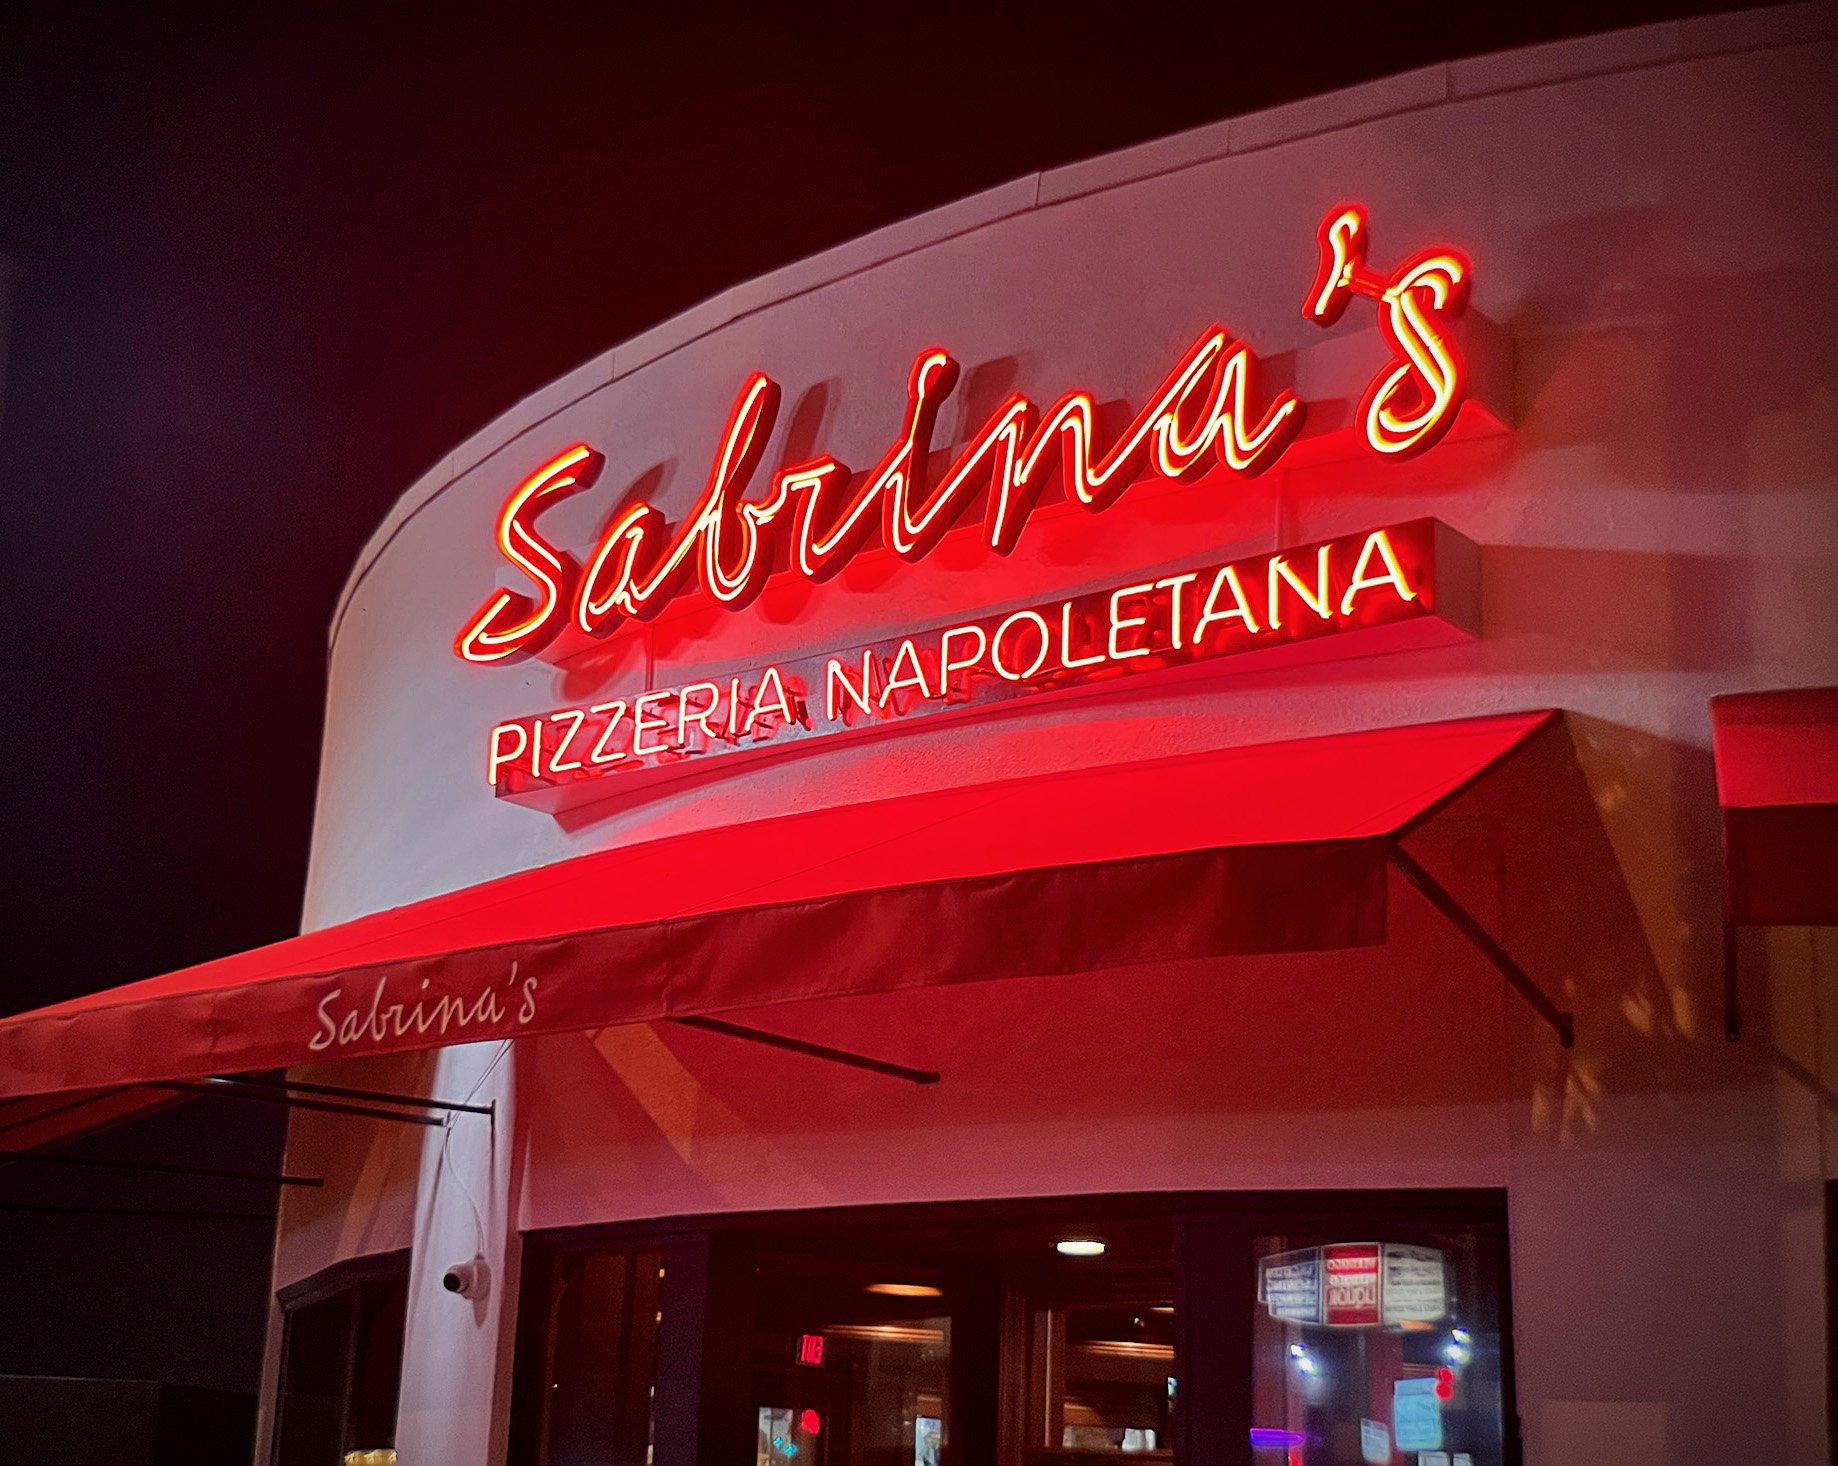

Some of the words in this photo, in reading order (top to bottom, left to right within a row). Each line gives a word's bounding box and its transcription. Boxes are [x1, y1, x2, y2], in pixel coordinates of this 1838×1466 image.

[456, 203, 1473, 664] Sabrina's
[488, 665, 796, 787] PIZZERIA
[825, 529, 1417, 719] NAPOLETANA
[308, 961, 538, 1051] Sabrina's
